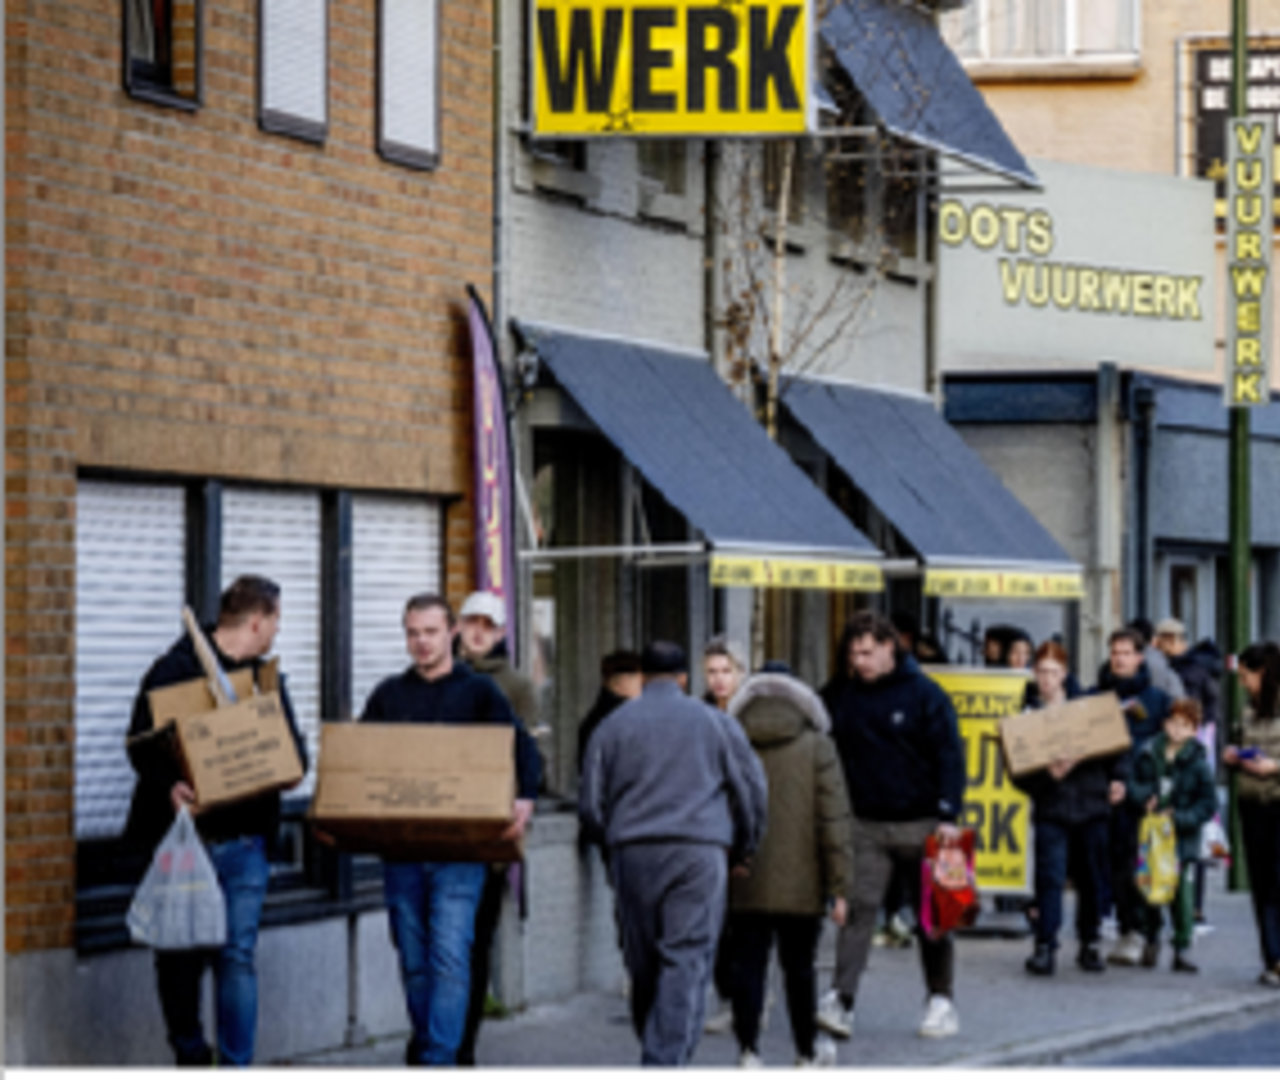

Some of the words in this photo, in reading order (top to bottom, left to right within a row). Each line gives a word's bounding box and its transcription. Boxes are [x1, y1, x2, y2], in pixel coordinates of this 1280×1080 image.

[536, 4, 804, 114] WERK
[998, 256, 1204, 322] VUURWERK
[1232, 120, 1267, 404] VUURWERK
